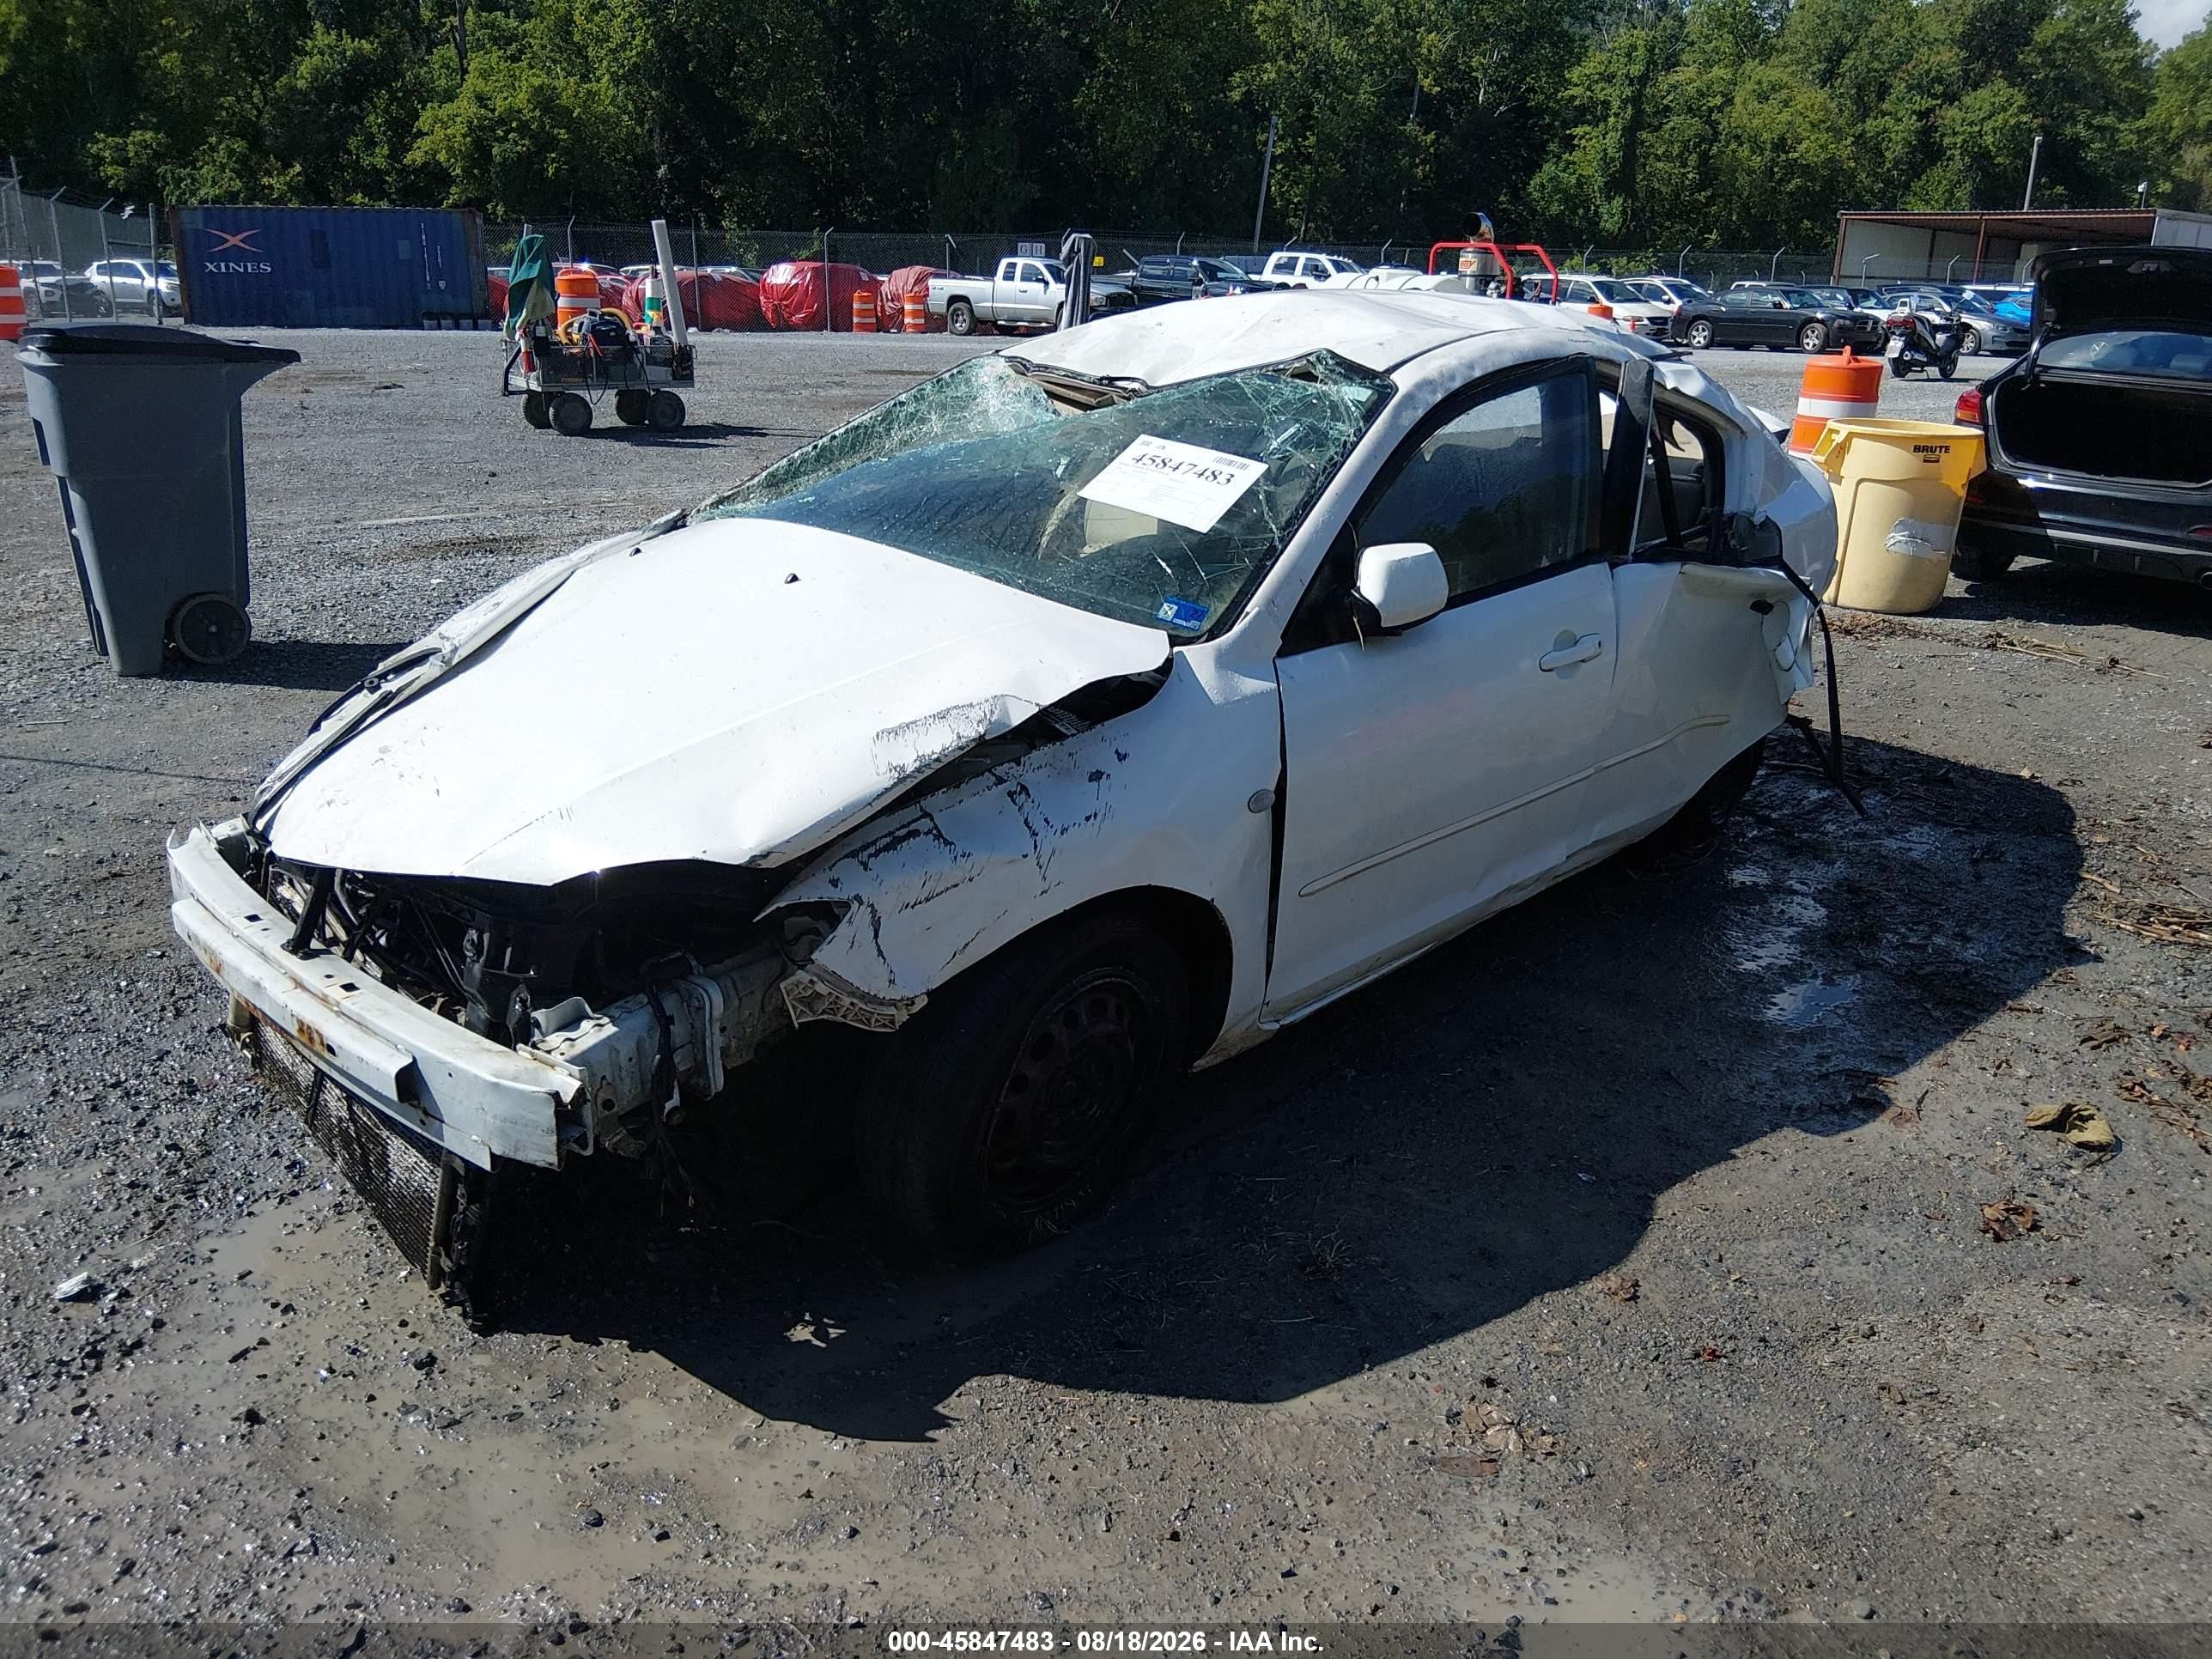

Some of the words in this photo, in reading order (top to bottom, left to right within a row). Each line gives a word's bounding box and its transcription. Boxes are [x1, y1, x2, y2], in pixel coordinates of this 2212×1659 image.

[1035, 245, 1043, 255] H
[204, 261, 272, 273] XINES
[1913, 445, 1951, 454] BRUTE
[1132, 453, 1235, 485] 45847483
